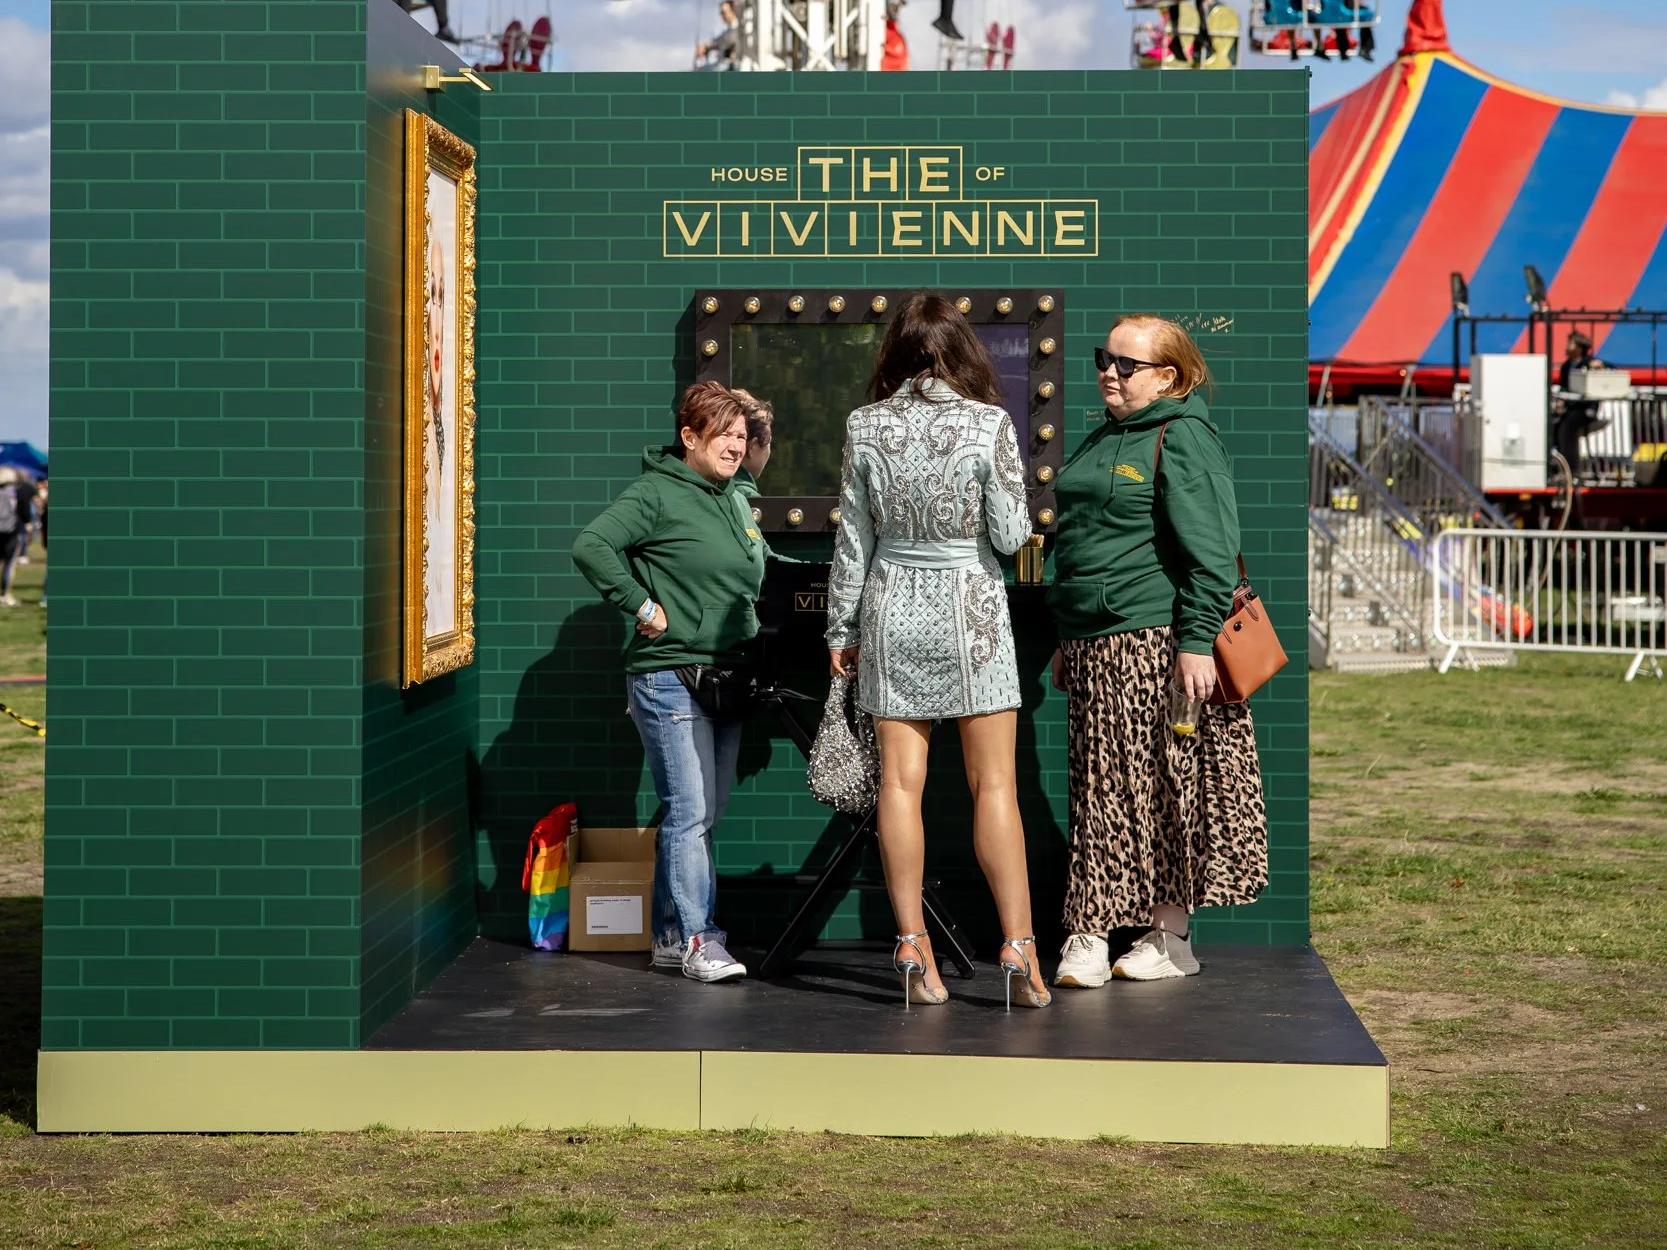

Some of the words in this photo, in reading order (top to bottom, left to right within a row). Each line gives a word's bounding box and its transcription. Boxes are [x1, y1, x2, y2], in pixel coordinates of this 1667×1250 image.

[711, 167, 788, 182] HOUSE
[808, 157, 950, 192] THE
[975, 166, 1005, 181] OF
[672, 211, 1085, 246] VIVIENNE
